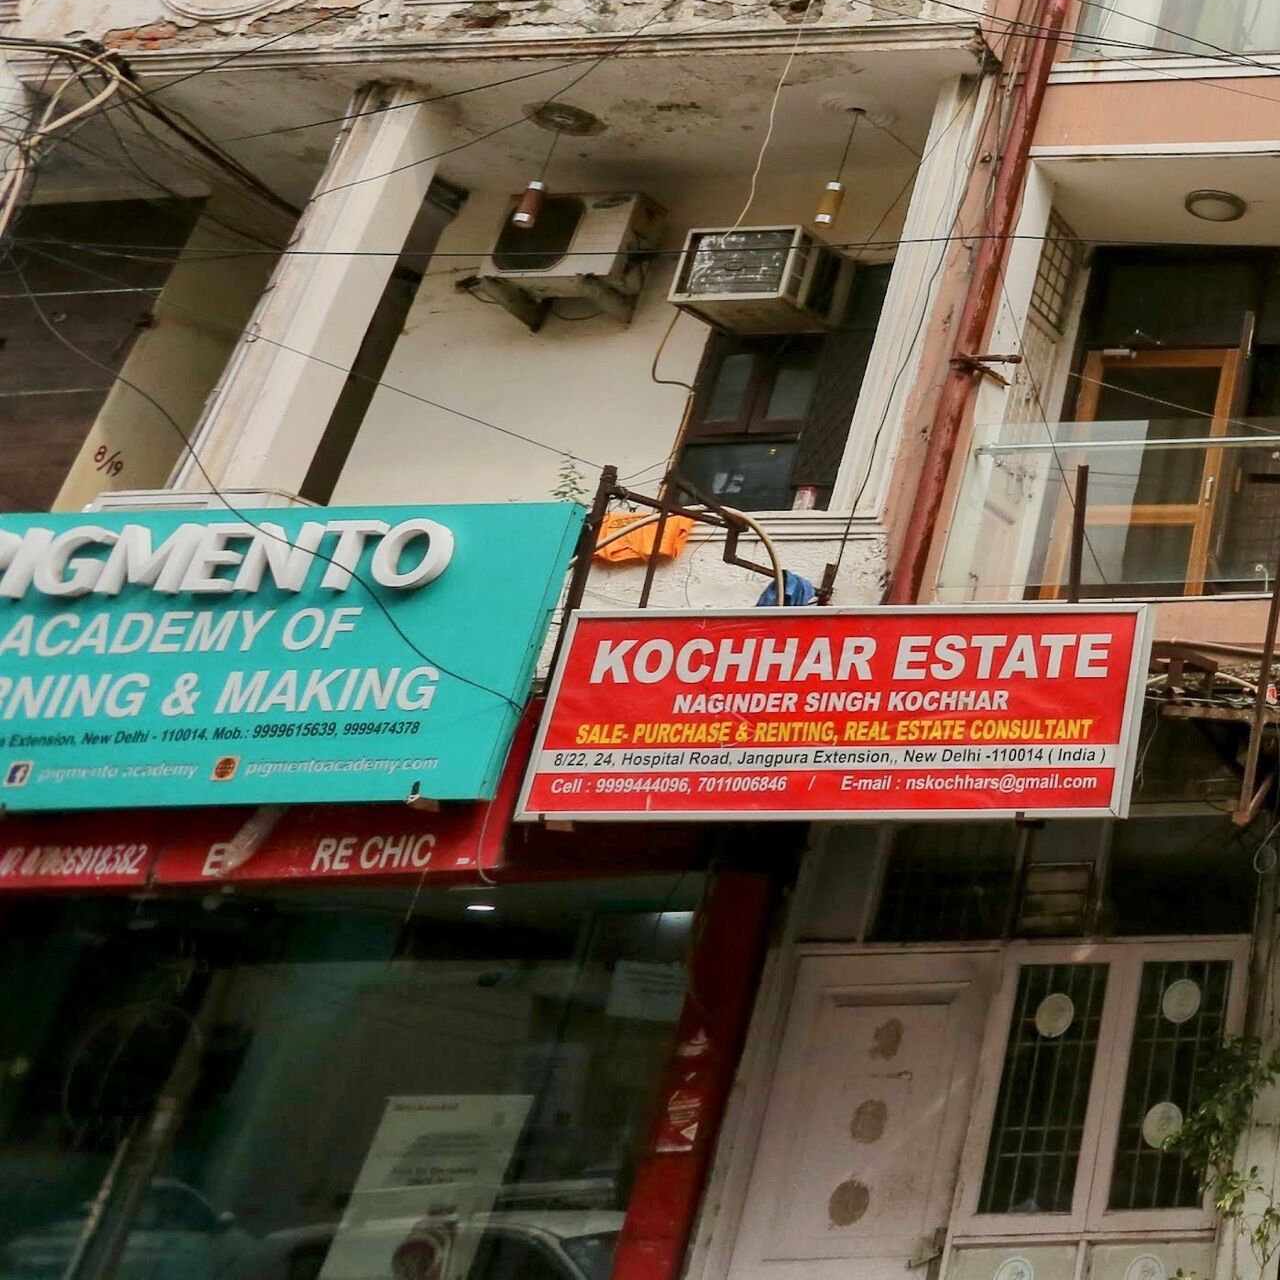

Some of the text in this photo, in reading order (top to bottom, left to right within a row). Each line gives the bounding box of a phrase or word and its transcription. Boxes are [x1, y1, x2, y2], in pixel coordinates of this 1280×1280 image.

[94, 445, 124, 477] 8/19
[0, 606, 363, 658] ACADEMY OF
[589, 632, 1113, 685] KOCHHAR ESTATE
[161, 670, 201, 717] &
[215, 665, 441, 716] MAKING
[672, 688, 1009, 714] NAGINDER SINGH KOCHHAR
[81, 732, 111, 745] New
[114, 729, 149, 745] Delhi
[252, 721, 339, 739] 9999615639,
[343, 721, 421, 736] 9999474378
[576, 718, 1094, 745] SALE- PURCHASE & RENTING, REAL ESTATE CONSULTANT
[246, 756, 439, 778] pigmentoacademy.com
[554, 752, 588, 768] 8/22,
[594, 752, 616, 768] 24,
[621, 751, 684, 769] Hospital
[689, 751, 733, 767] Road,
[737, 750, 808, 769] Jangpura
[904, 749, 937, 763] New
[941, 748, 981, 763] Delhi
[1057, 747, 1096, 762] India
[37, 761, 199, 784] pigmento academy
[551, 777, 582, 793] Cell
[595, 776, 692, 795] 9999444096,
[697, 776, 788, 792] 7011006846
[840, 775, 892, 791] E-mail
[905, 773, 1097, 793] nskochhars@gmail.com
[359, 834, 436, 870] CHIC
